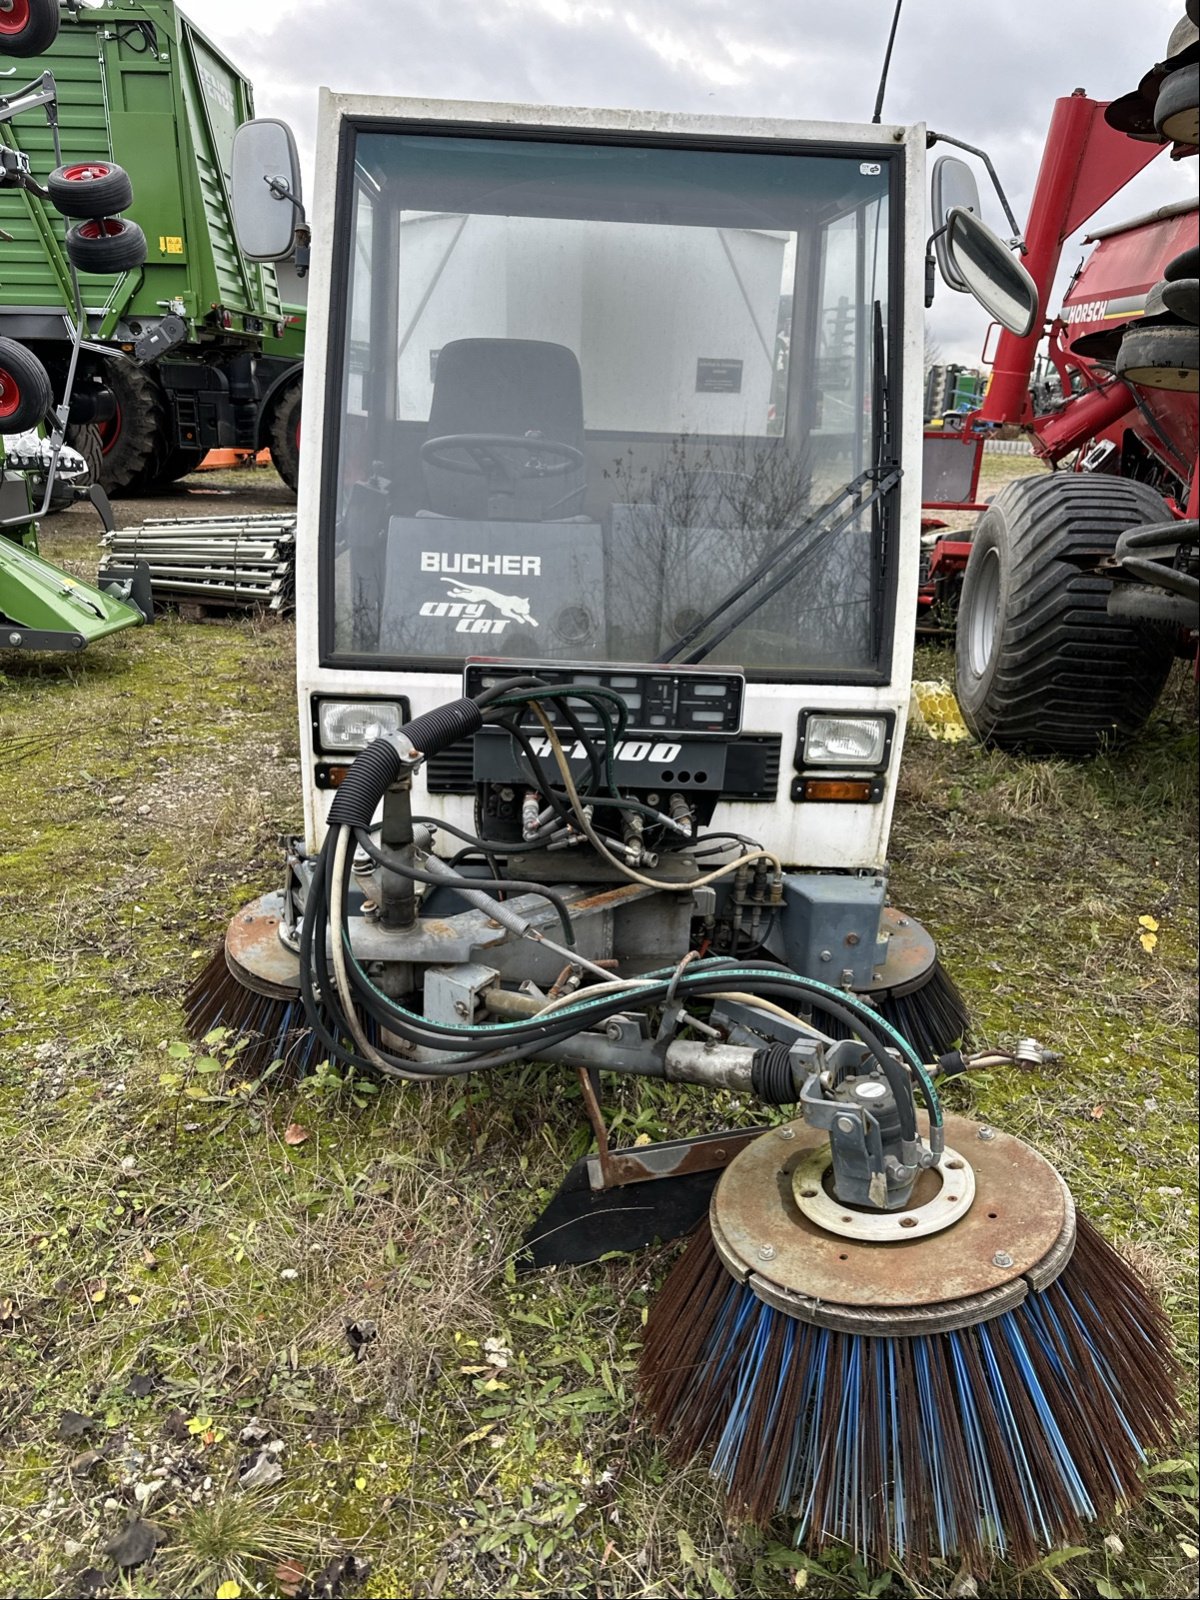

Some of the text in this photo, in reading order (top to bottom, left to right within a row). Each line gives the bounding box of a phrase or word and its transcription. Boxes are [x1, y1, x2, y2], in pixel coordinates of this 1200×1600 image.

[1068, 300, 1109, 324] HORSCH
[420, 551, 542, 576] BUCHER
[418, 602, 487, 618] CITY
[455, 618, 511, 634] CAT
